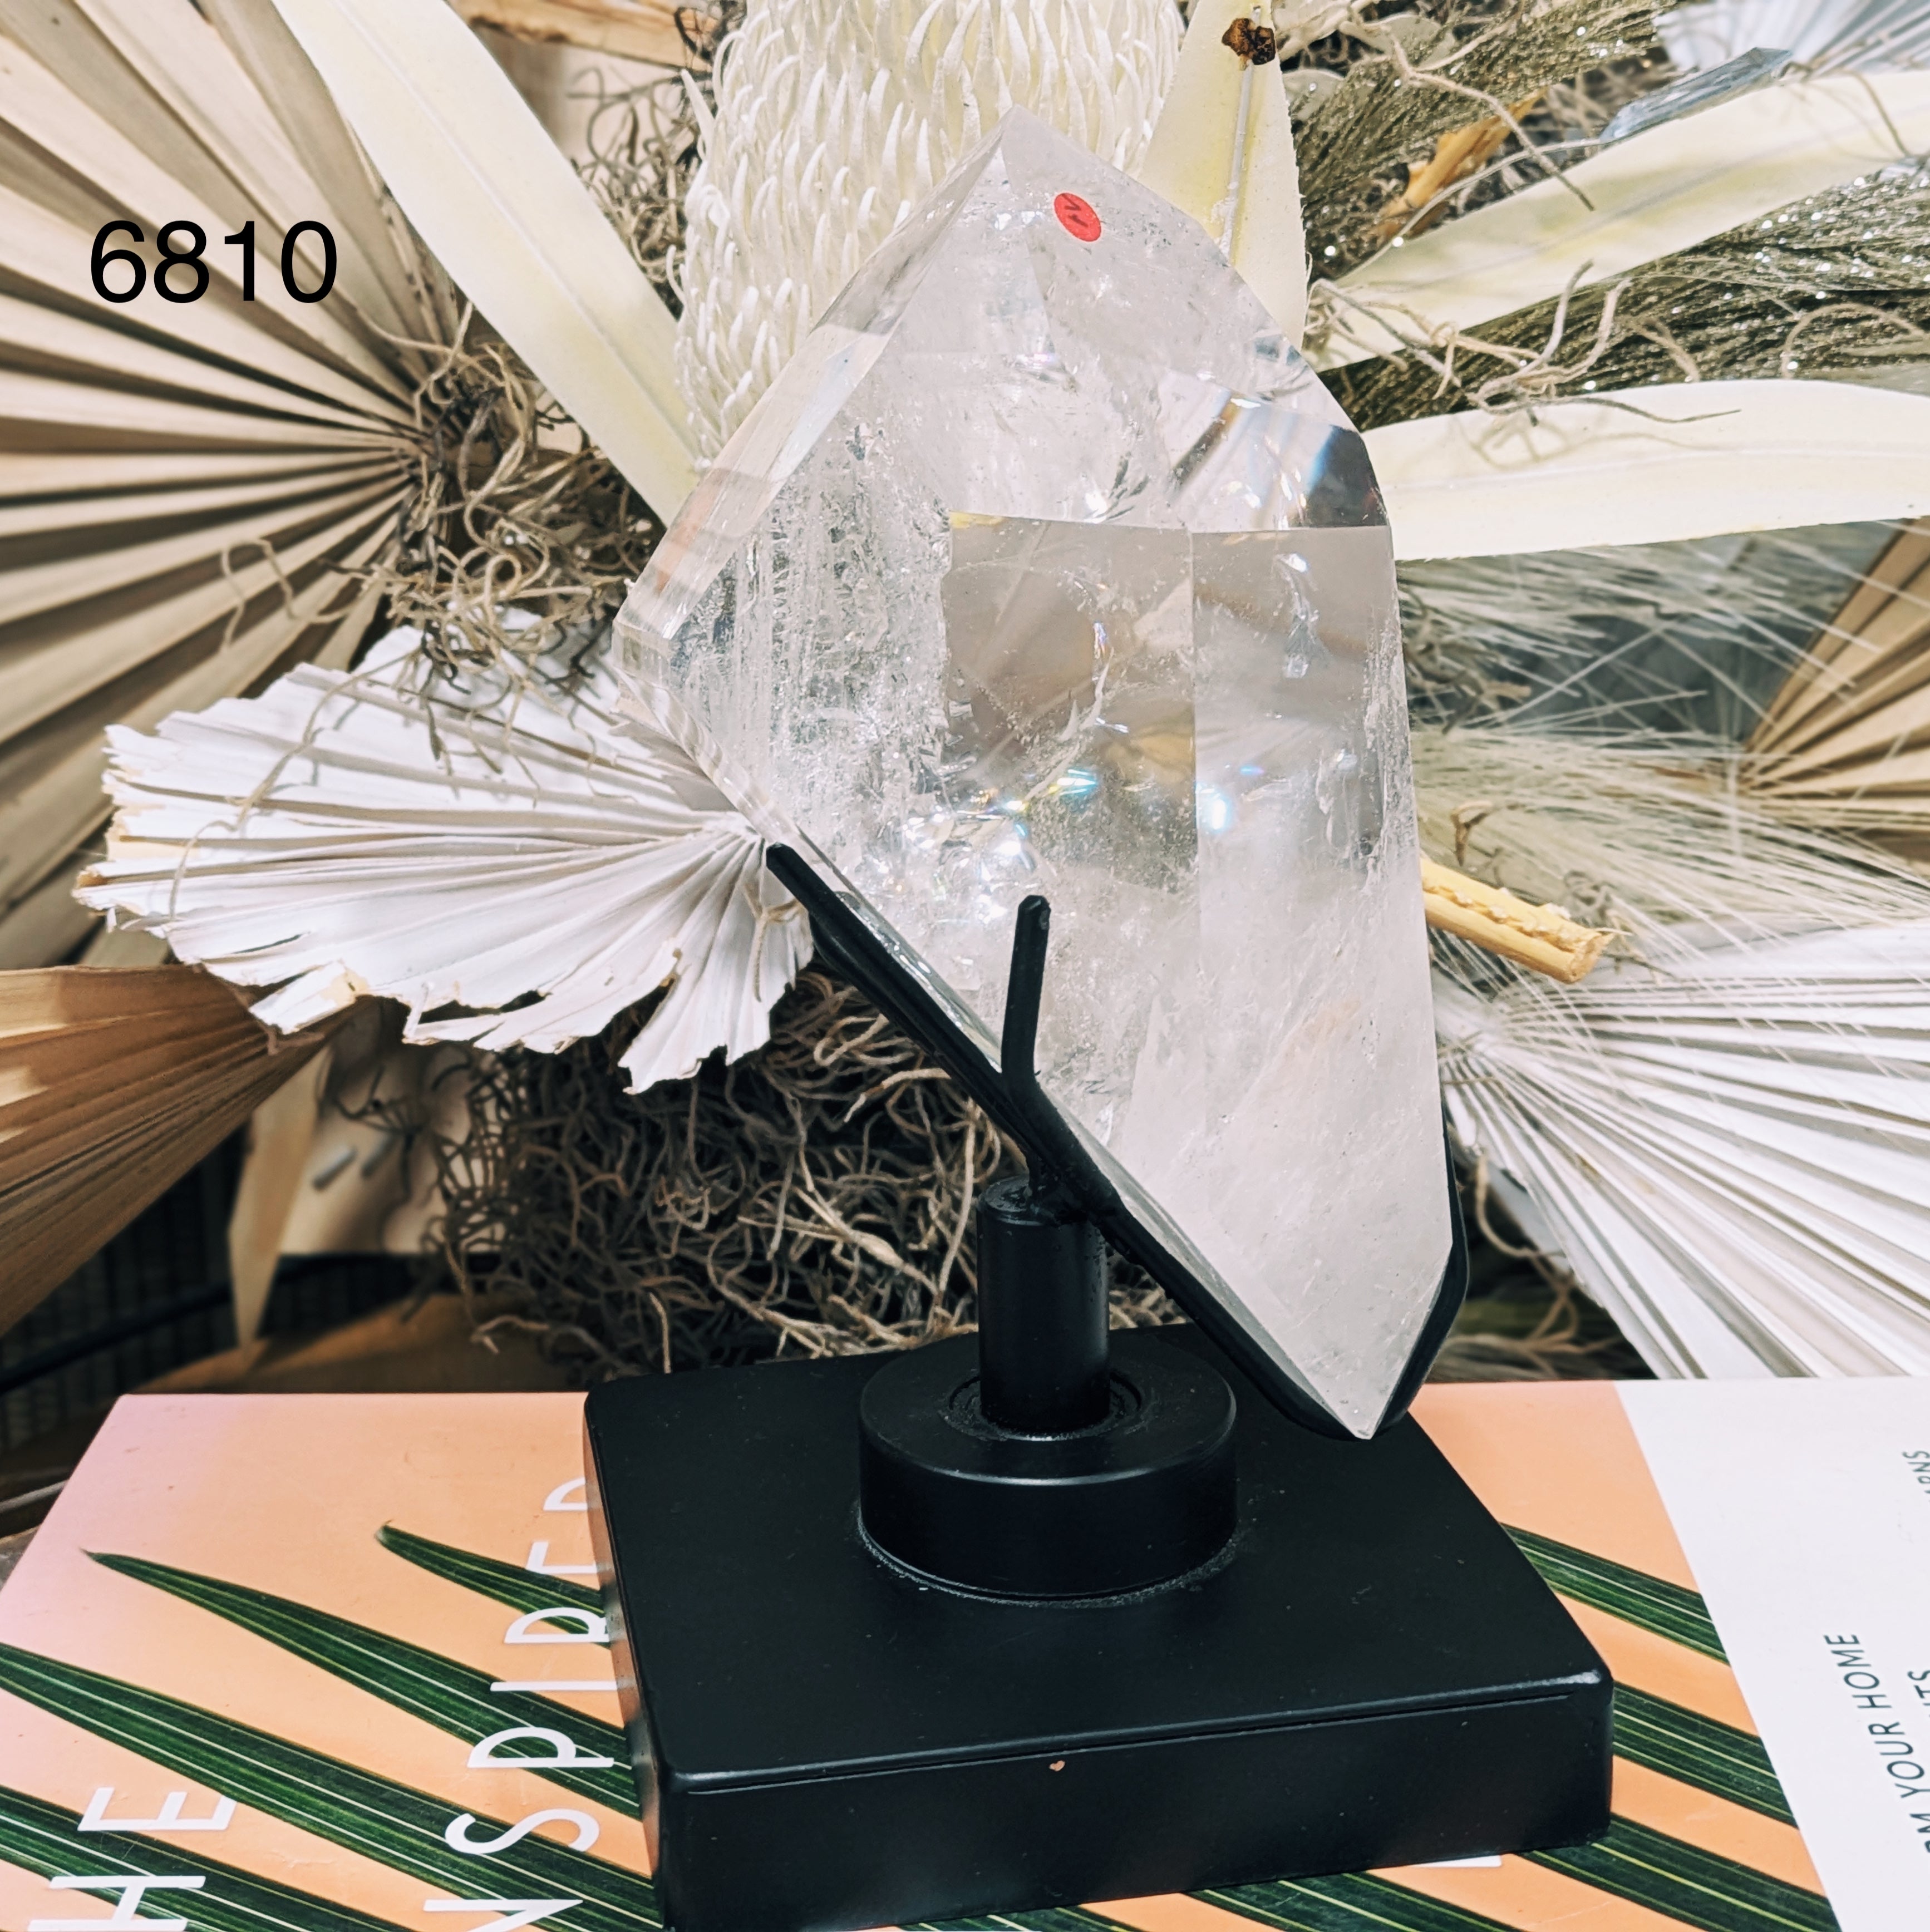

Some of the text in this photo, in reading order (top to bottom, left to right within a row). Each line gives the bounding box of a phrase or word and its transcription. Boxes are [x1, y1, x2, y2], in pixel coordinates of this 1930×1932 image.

[1902, 1450, 1930, 1495] NS
[1823, 1634, 1892, 1709] HOME
[1868, 1722, 1930, 1798] YOUR
